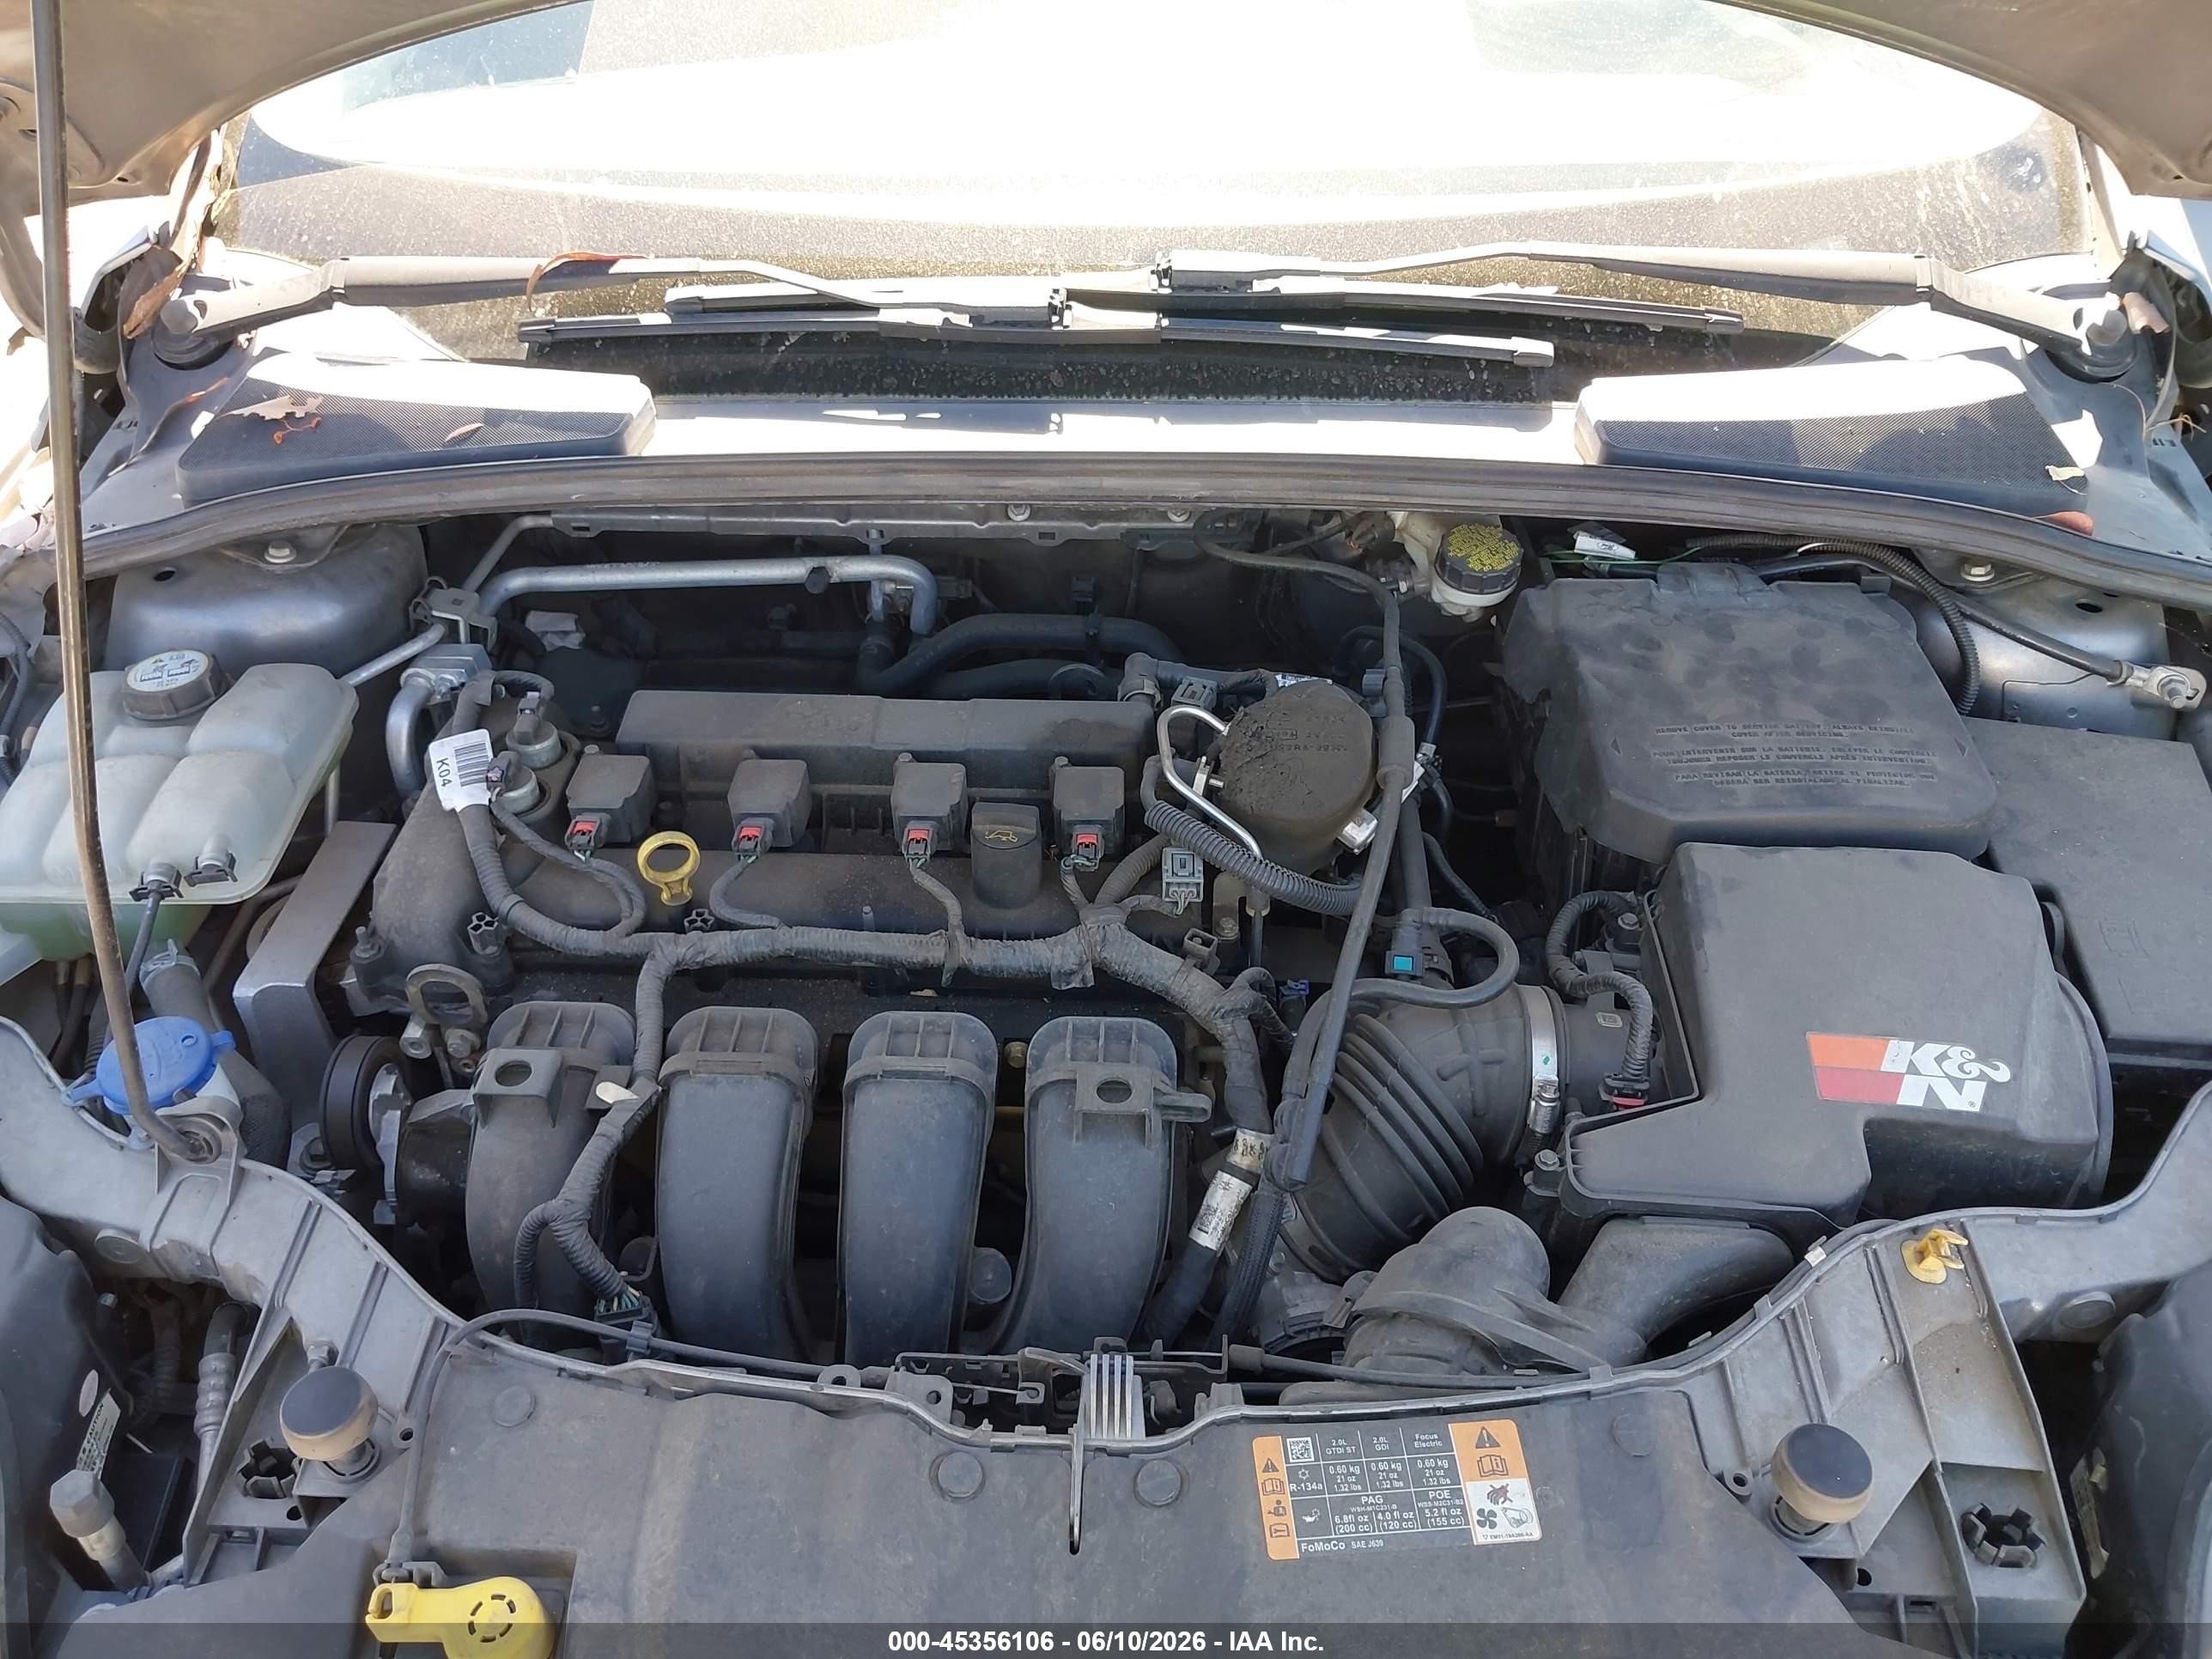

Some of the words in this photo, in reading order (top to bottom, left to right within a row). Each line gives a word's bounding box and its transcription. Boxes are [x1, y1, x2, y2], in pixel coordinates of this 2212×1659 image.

[436, 757, 453, 788] K04
[87, 1403, 104, 1444] CAUTION
[1370, 1462, 1389, 1471] 0.60
[1390, 1461, 1402, 1471] kg
[1417, 1459, 1436, 1468] 0.60
[1437, 1458, 1449, 1468] kg
[1328, 1465, 1346, 1474] 0.60
[1349, 1464, 1360, 1474] kg
[1290, 1482, 1322, 1492] R-134a
[1423, 1478, 1437, 1486] 1.32
[1361, 1495, 1383, 1504] PAG
[1429, 1490, 1452, 1499] POE
[1376, 1511, 1391, 1521] 4.0
[1393, 1510, 1401, 1519] fl
[1425, 1508, 1439, 1517] 5.2
[1441, 1507, 1448, 1516] fl
[1379, 1521, 1400, 1532] (120
[1402, 1519, 1417, 1530] cc)
[1427, 1517, 1448, 1528] (155
[1449, 1516, 1465, 1526] cc)
[1335, 1523, 1356, 1534] (200
[1358, 1522, 1373, 1533] cc)
[1301, 1540, 1346, 1553] FoMoCo
[1351, 1540, 1366, 1549] SAE
